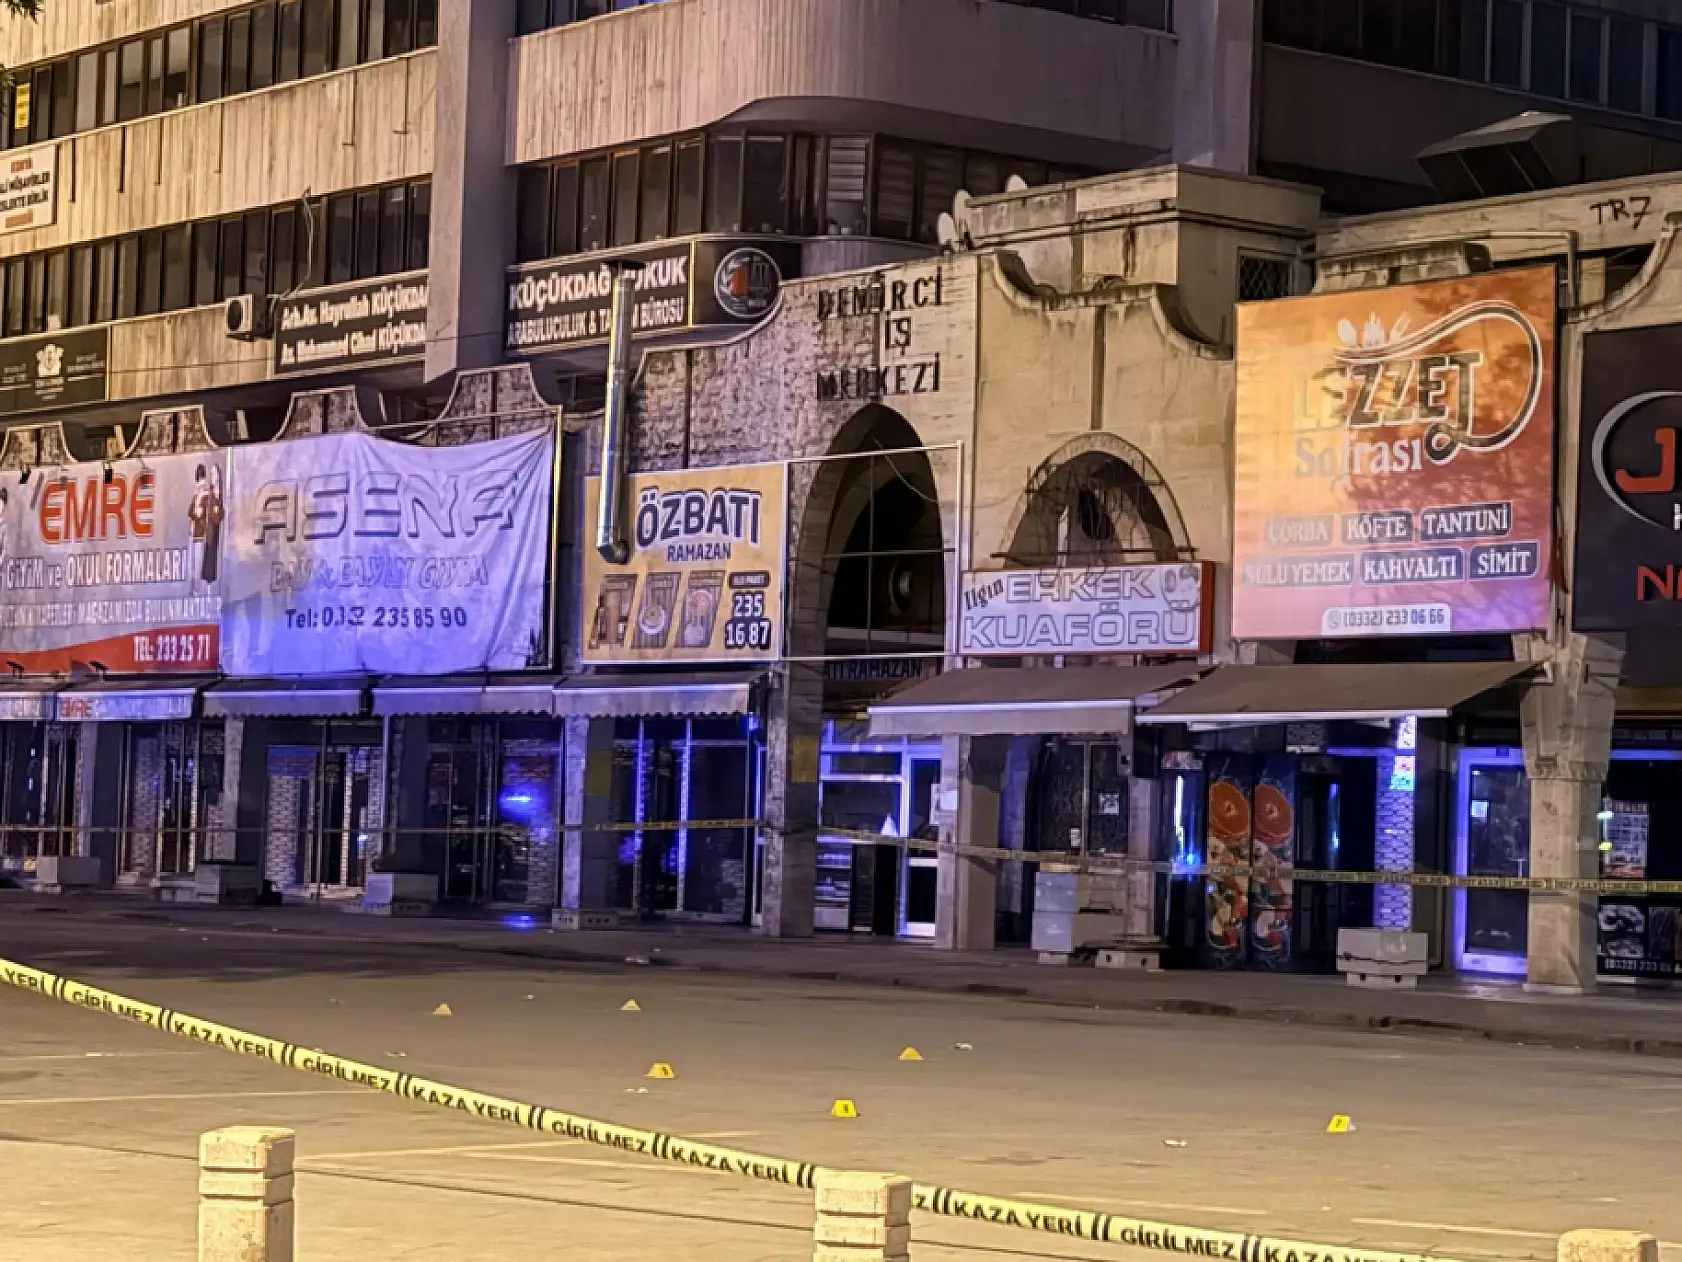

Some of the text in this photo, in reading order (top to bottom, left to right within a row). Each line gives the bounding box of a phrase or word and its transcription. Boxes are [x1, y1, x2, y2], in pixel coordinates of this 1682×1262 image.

[372, 283, 428, 318] KÜÇÜKDA
[509, 262, 611, 312] KÜÇÜKDAĞ
[379, 320, 426, 354] KÜÇÜKDA
[885, 312, 912, 355] İŞ
[1295, 436, 1422, 492] Sofrası
[40, 470, 156, 544] EMRE
[254, 471, 519, 545] ASENA
[637, 486, 762, 547] ÖZBATI
[1347, 513, 1407, 540] KÖFTE
[1424, 504, 1509, 536] TANTUNİ
[67, 553, 101, 587] OKUL
[106, 549, 187, 584] FORMALARI
[667, 542, 731, 562] RAMAZAN
[1292, 558, 1350, 583] YEMEK
[1364, 554, 1457, 581] KAHVALTI
[1477, 546, 1531, 575] SİMİT
[1006, 567, 1155, 604] ERKEK
[373, 607, 410, 628] 235
[441, 606, 467, 628] 90
[733, 594, 763, 617] 235
[726, 621, 769, 645] 16 87
[963, 602, 1195, 649] KUAFÖRÜ
[551, 1117, 647, 1152] GİRİLMEZ
[671, 1146, 732, 1172] KAZA
[737, 1157, 790, 1184] YERİ
[954, 1200, 1022, 1227] KAZA
[1026, 1209, 1084, 1238] YERİ
[1120, 1224, 1235, 1259] GİRİLMEZ
